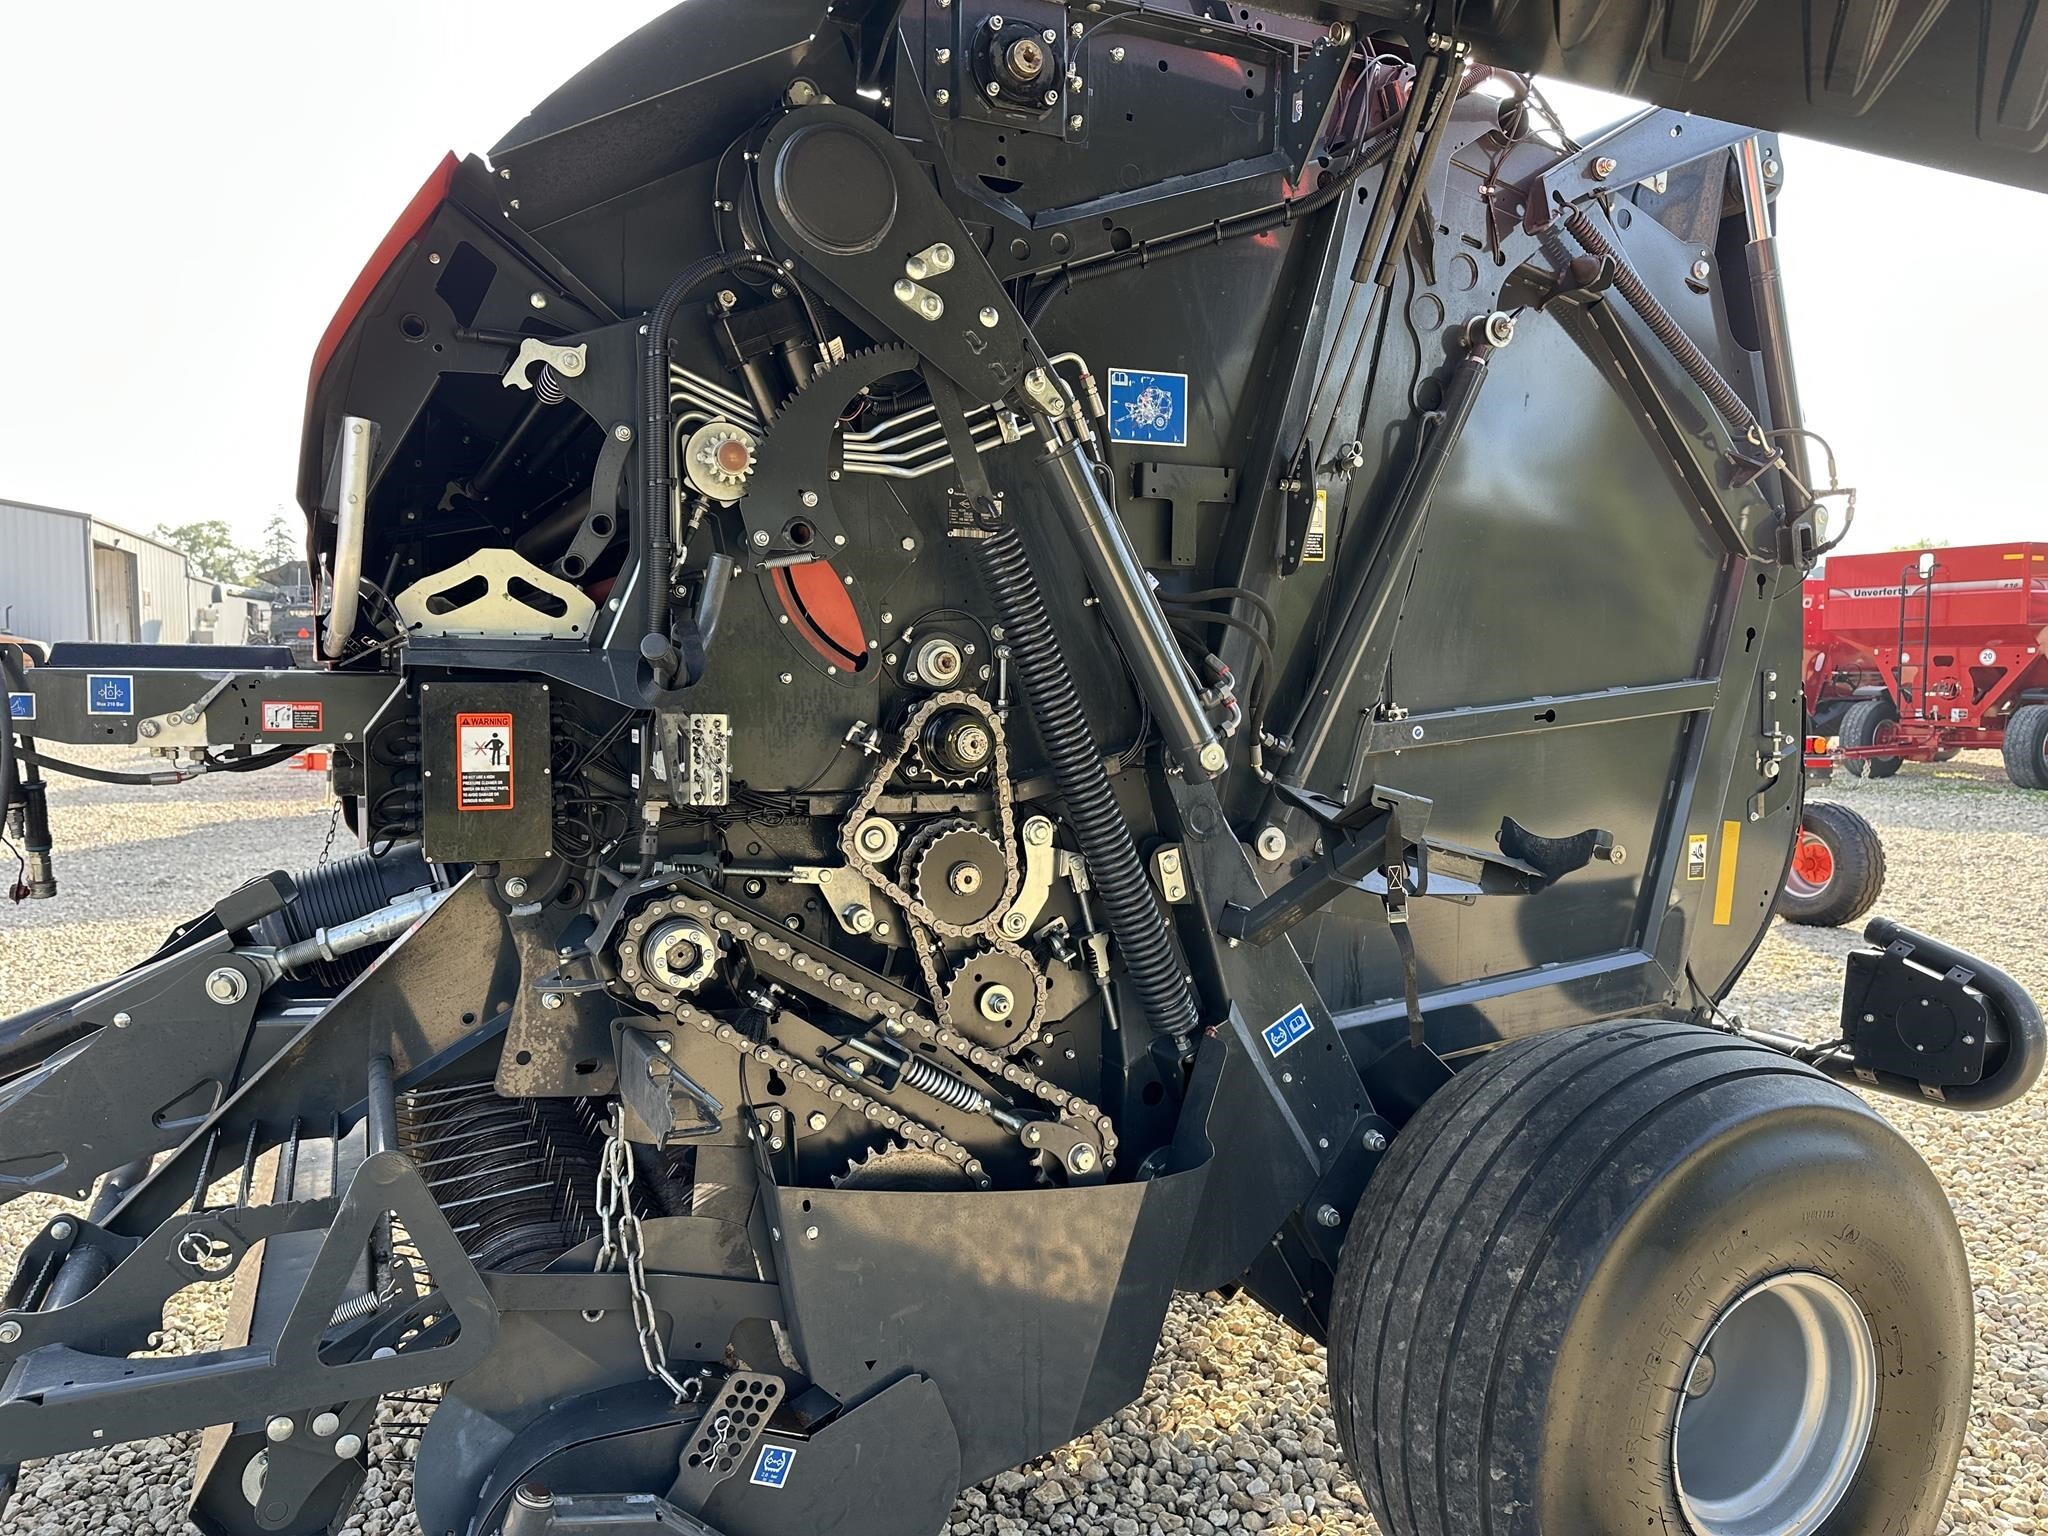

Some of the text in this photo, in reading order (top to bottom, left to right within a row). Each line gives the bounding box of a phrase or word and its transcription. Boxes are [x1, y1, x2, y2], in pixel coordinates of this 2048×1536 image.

[1853, 587, 1909, 597] Unverferth
[1983, 652, 1993, 660] 20
[471, 718, 509, 726] WARNING
[1637, 1265, 1706, 1394] IMPLEMENT
